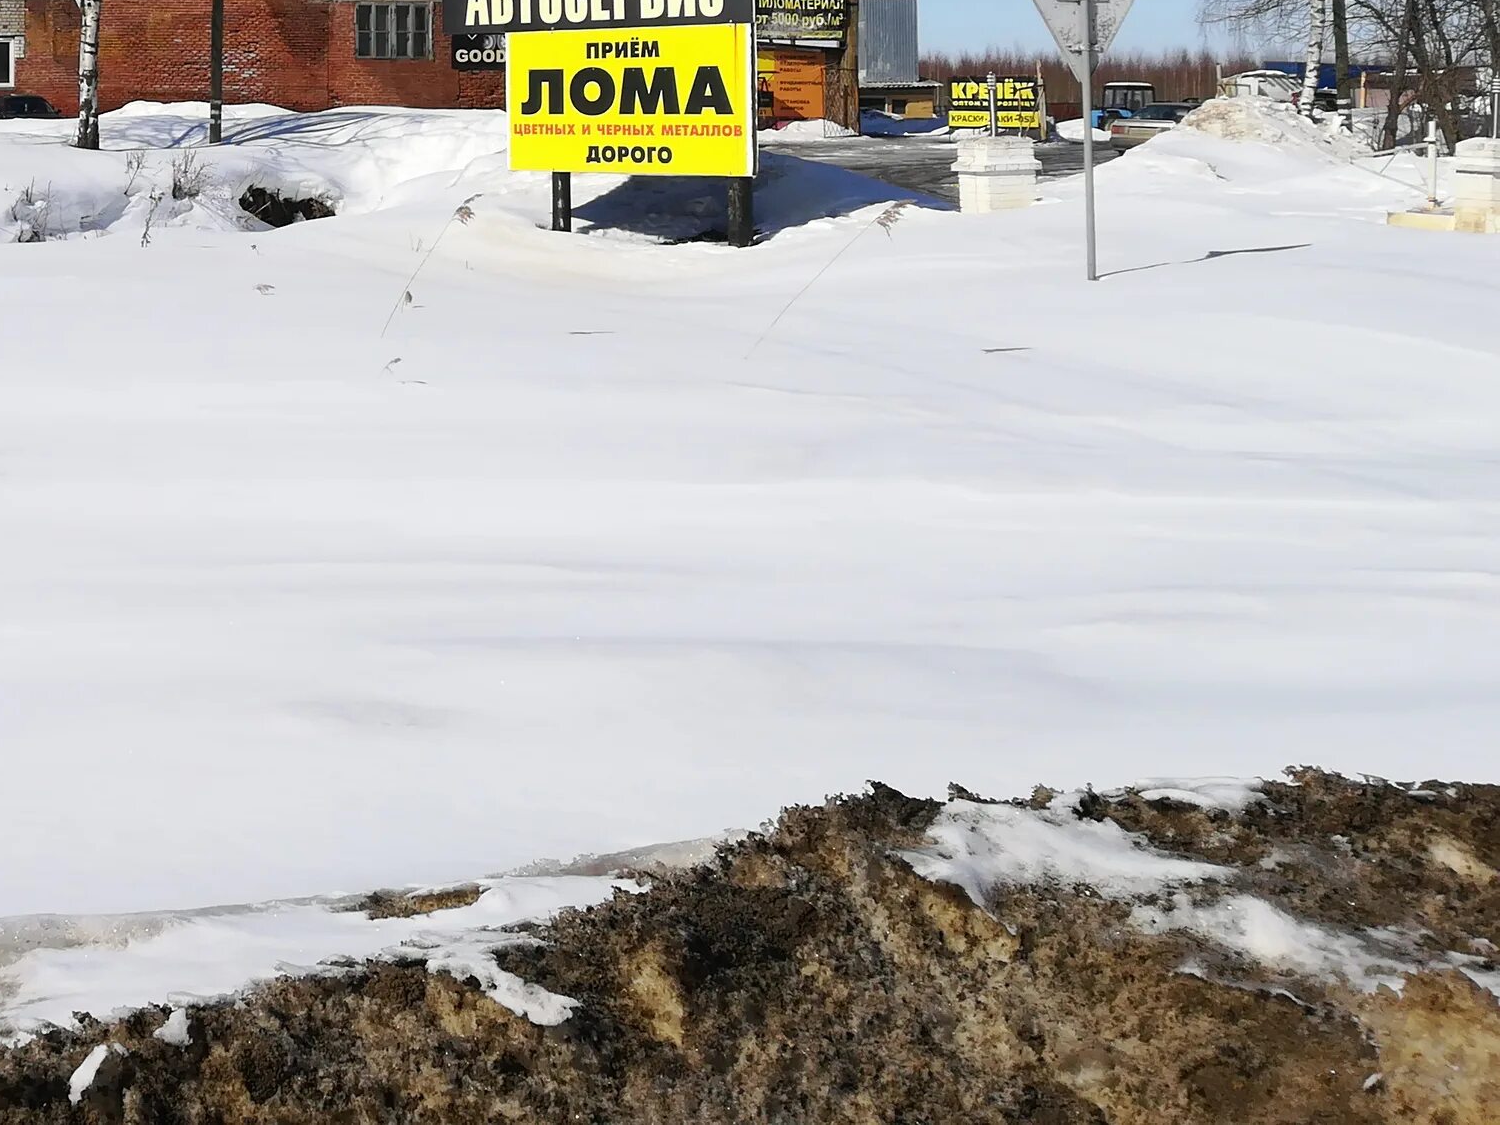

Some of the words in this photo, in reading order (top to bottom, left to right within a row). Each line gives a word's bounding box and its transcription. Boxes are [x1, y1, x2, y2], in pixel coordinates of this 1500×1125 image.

[586, 37, 659, 59] ПРИЁМ
[521, 66, 734, 115] ЛОМА
[514, 124, 576, 136] ЦВЕТНЫХ
[582, 124, 591, 135] И
[597, 124, 654, 136] ЧЕРНЫХ
[661, 124, 742, 137] МЕТАЛЛОВ
[586, 146, 672, 164] ДОРОГО
